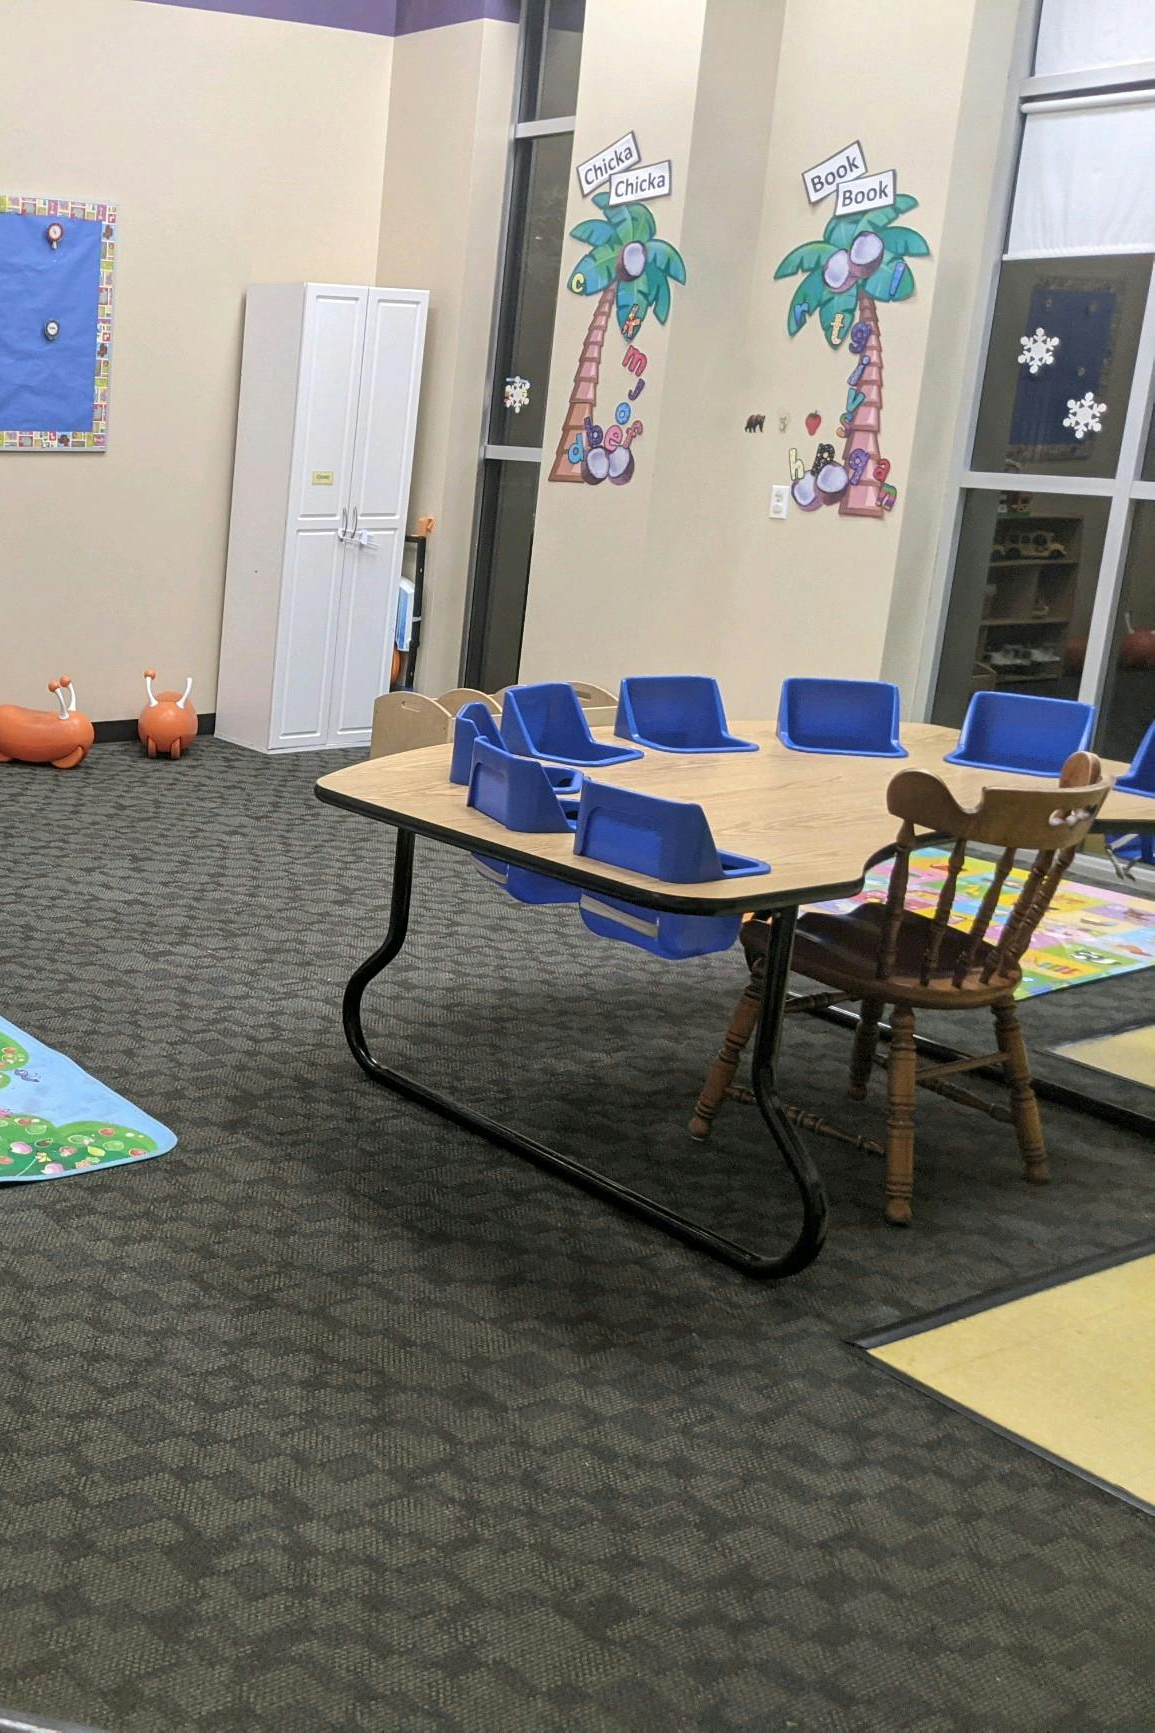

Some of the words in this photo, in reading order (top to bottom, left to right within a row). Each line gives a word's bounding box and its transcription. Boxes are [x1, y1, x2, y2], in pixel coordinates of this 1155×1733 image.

[584, 146, 633, 185] Chicka
[810, 155, 860, 193] Book
[614, 172, 666, 197] Chicka
[841, 180, 889, 208] Book
